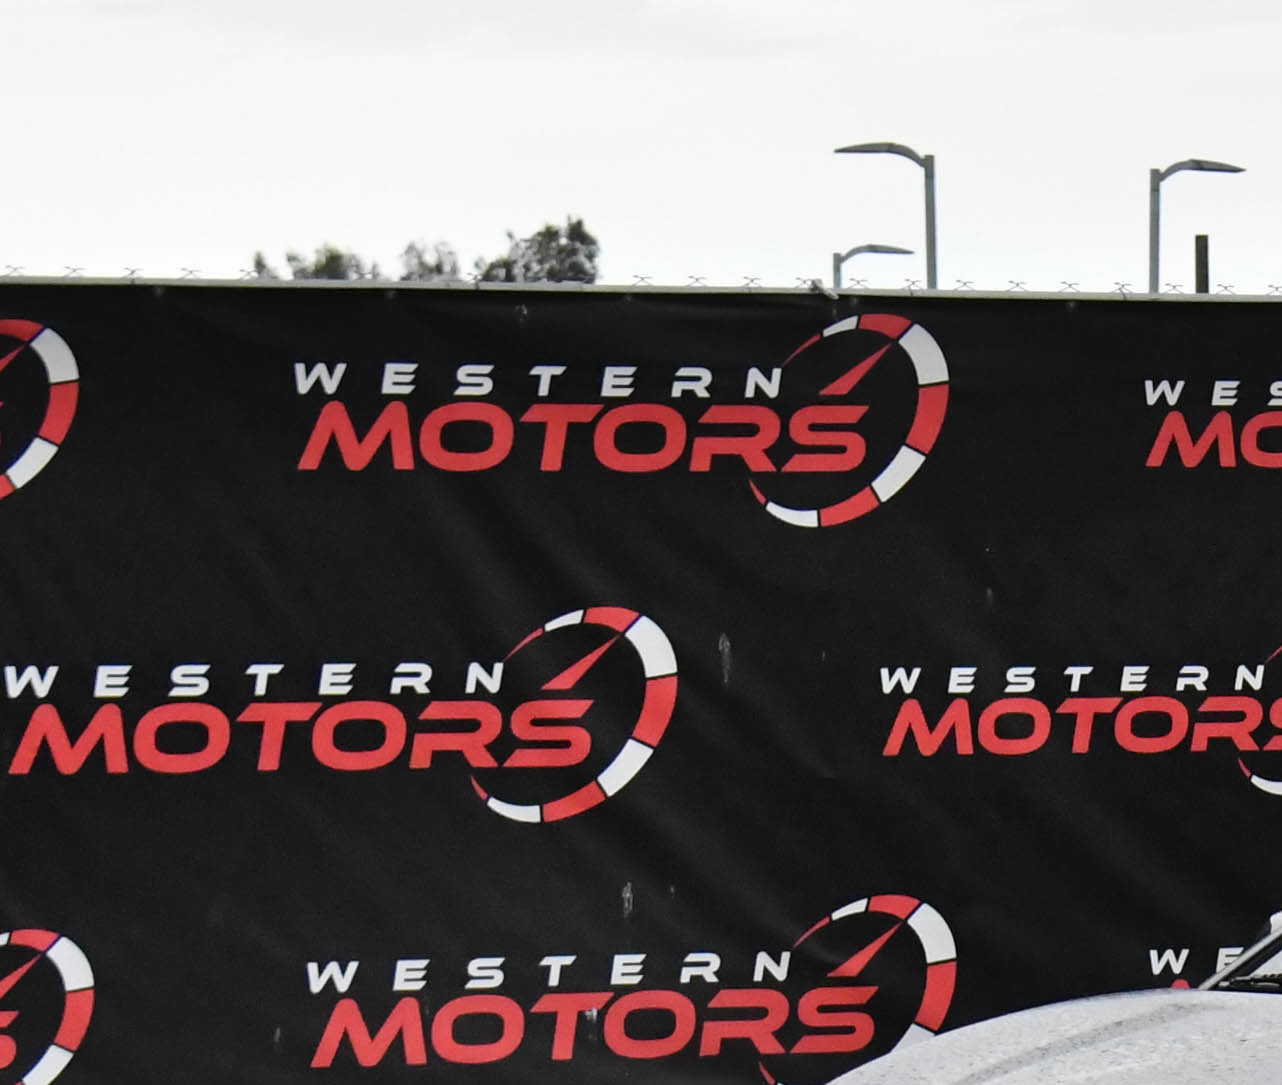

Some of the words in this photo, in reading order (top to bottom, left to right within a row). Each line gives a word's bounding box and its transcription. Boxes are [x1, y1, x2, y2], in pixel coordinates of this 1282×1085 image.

[295, 362, 782, 398] WESTERN
[298, 400, 869, 473] MOTORS
[4, 662, 504, 699] WESTERN
[880, 664, 1265, 694] WESTERN
[7, 698, 594, 775] MOTORS
[307, 951, 791, 994] WESTERN
[310, 985, 879, 1068] MOTORS
